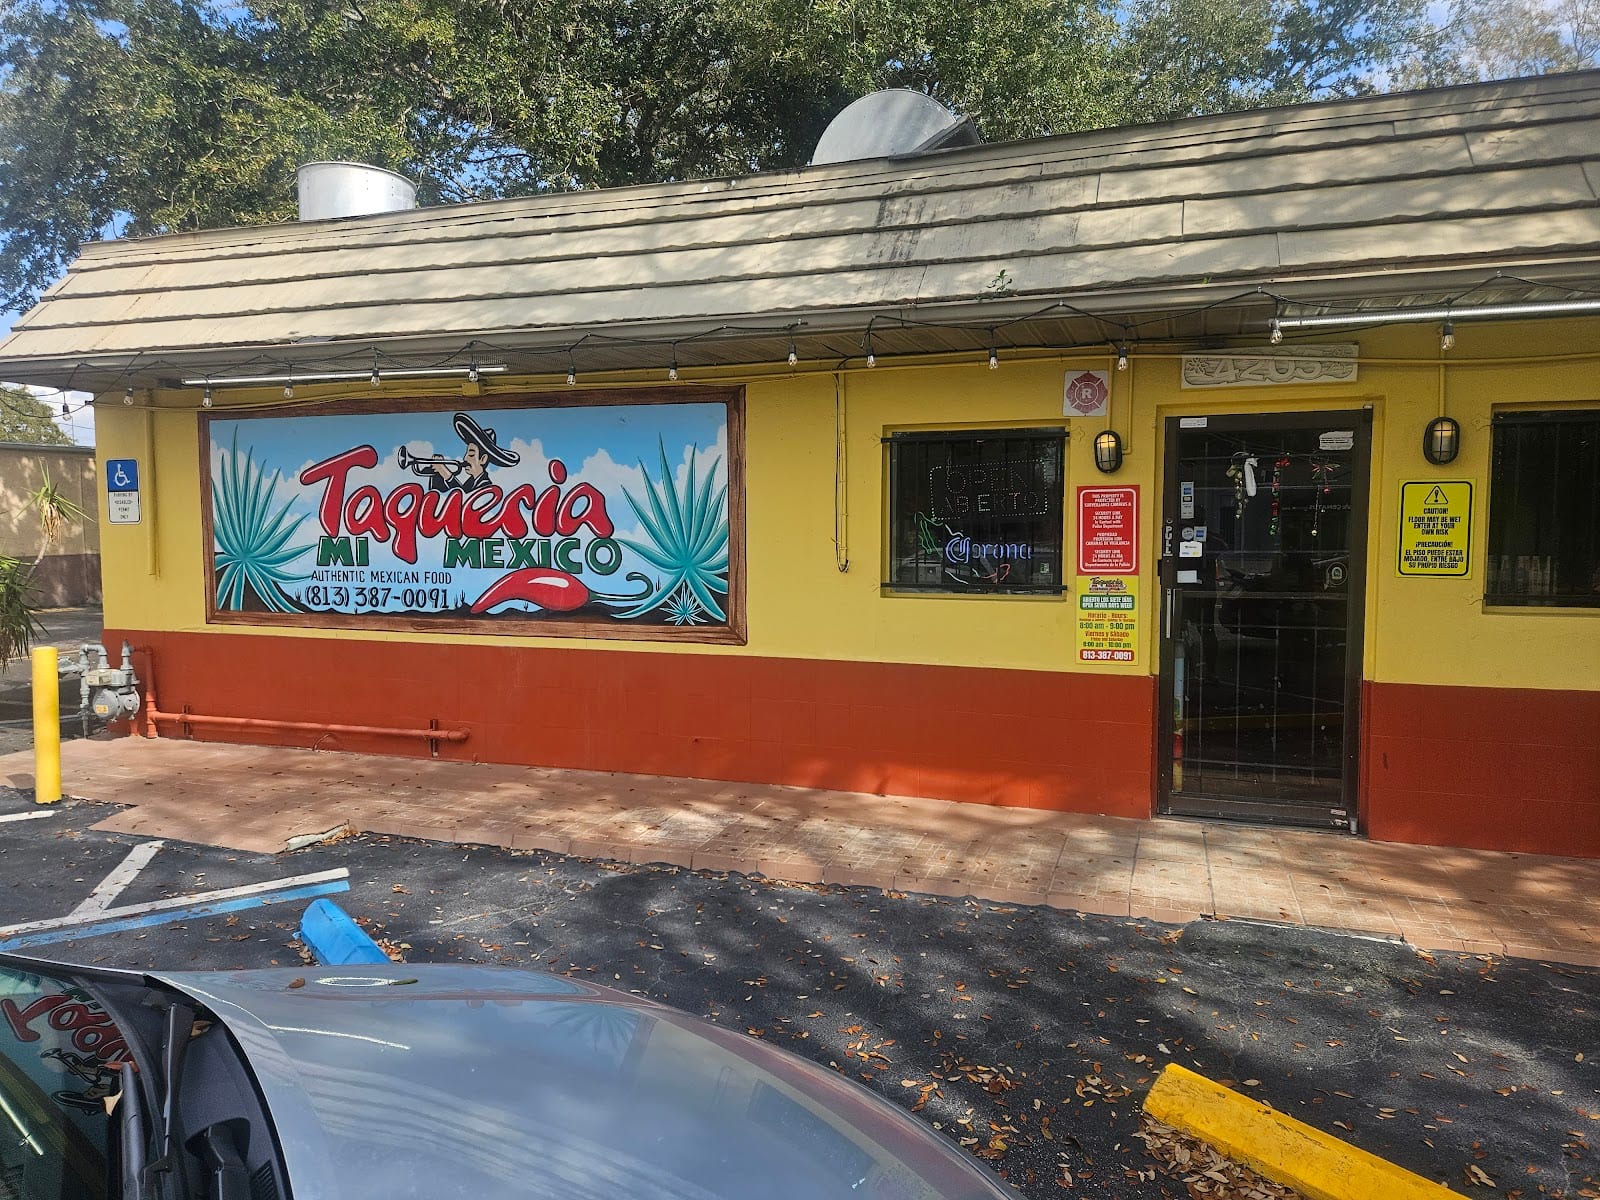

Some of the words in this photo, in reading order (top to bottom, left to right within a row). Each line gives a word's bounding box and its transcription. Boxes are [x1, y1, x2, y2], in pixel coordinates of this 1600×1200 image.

[1081, 388, 1092, 399] R
[946, 466, 1028, 493] OPEN
[300, 444, 614, 564] Taqueria
[316, 535, 369, 567] MI
[443, 537, 622, 576] MEXICO
[945, 536, 1032, 563] Corona
[311, 570, 365, 583] AUTHENTIC
[370, 571, 419, 584] MEXICAN
[424, 571, 452, 584] FOOD
[305, 585, 350, 607] (813)
[354, 586, 450, 608] 387-0091
[1082, 650, 1131, 660] 813-387-0091
